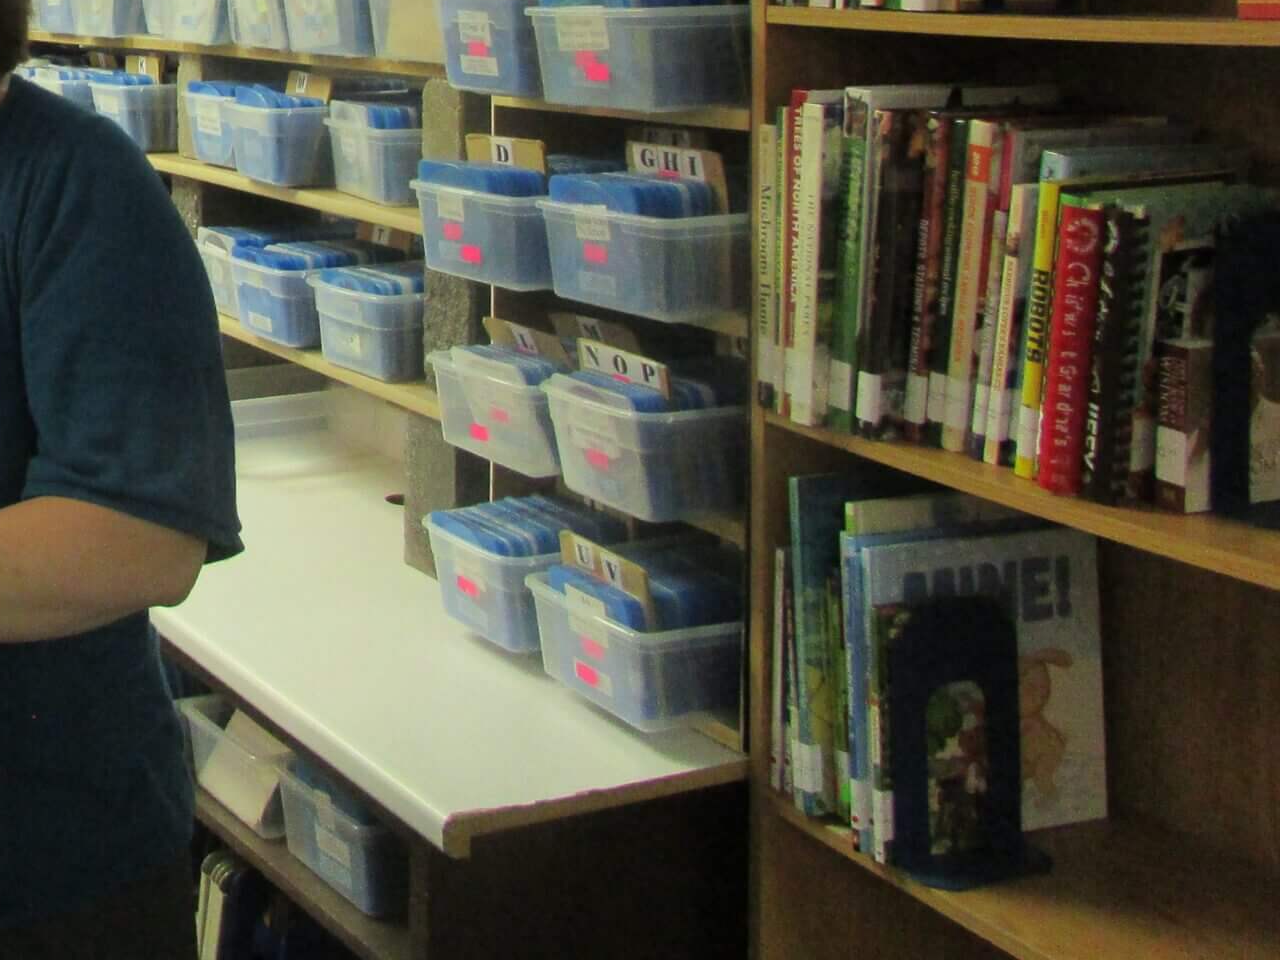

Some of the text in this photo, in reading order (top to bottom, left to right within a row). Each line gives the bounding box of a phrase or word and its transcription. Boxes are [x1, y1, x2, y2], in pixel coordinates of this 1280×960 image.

[495, 143, 510, 164] D
[640, 148, 697, 177] G H I
[790, 178, 802, 232] NORTH
[759, 183, 773, 277] Mushroom
[789, 235, 801, 304] AMERICA
[1026, 269, 1050, 364] ROBOTS
[613, 354, 628, 375] O
[641, 362, 656, 383] P
[575, 543, 618, 579] U V
